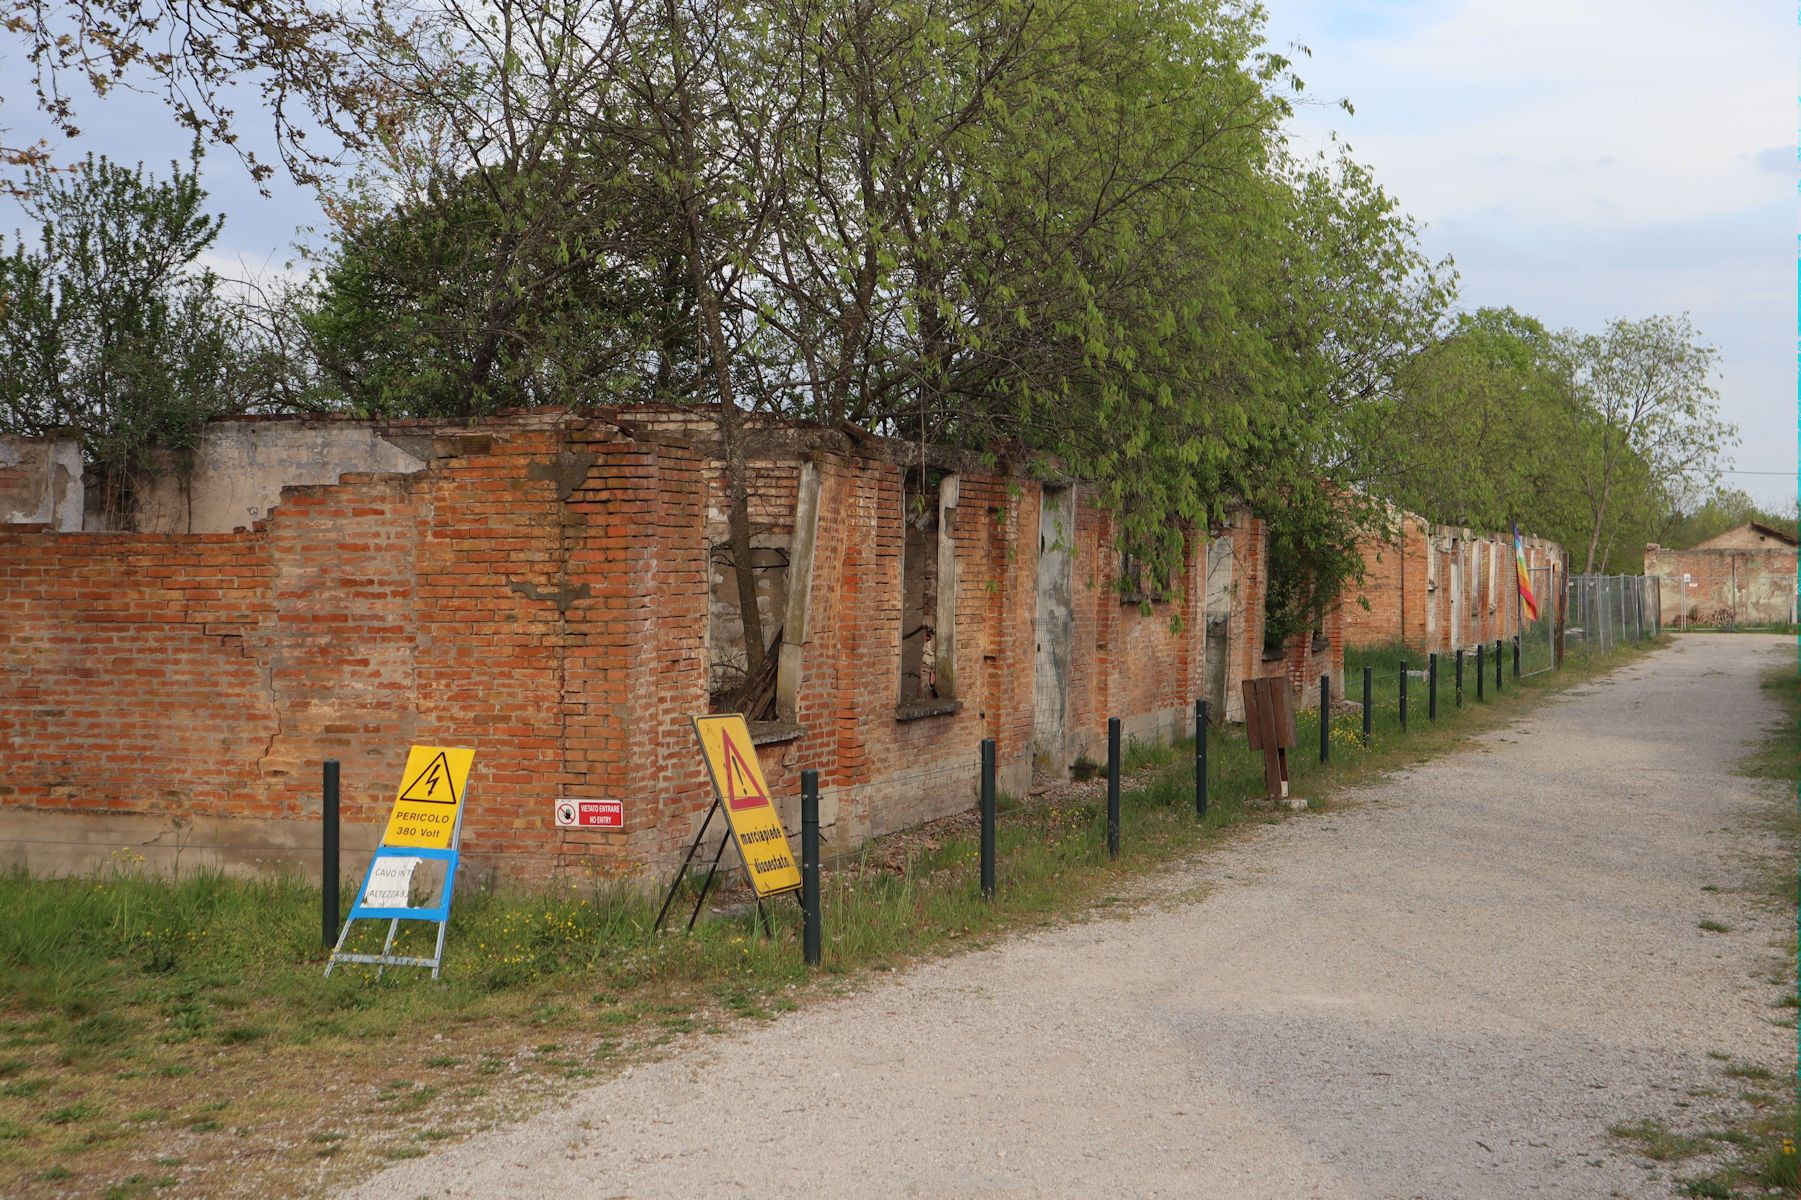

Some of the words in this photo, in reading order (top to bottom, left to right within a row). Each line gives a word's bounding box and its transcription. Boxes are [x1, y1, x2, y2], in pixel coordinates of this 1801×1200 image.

[581, 805, 598, 813] VIETATO
[599, 805, 620, 813] ENTRARE
[395, 811, 450, 824] PERICOLO
[589, 816, 597, 824] NO
[597, 816, 612, 824] ENTRY
[396, 826, 417, 836] 380
[420, 828, 440, 838] Volt
[740, 824, 782, 845] marciapiede
[754, 853, 790, 874] dissestato
[375, 868, 397, 878] CAVO
[368, 889, 399, 899] ALTEZZA
